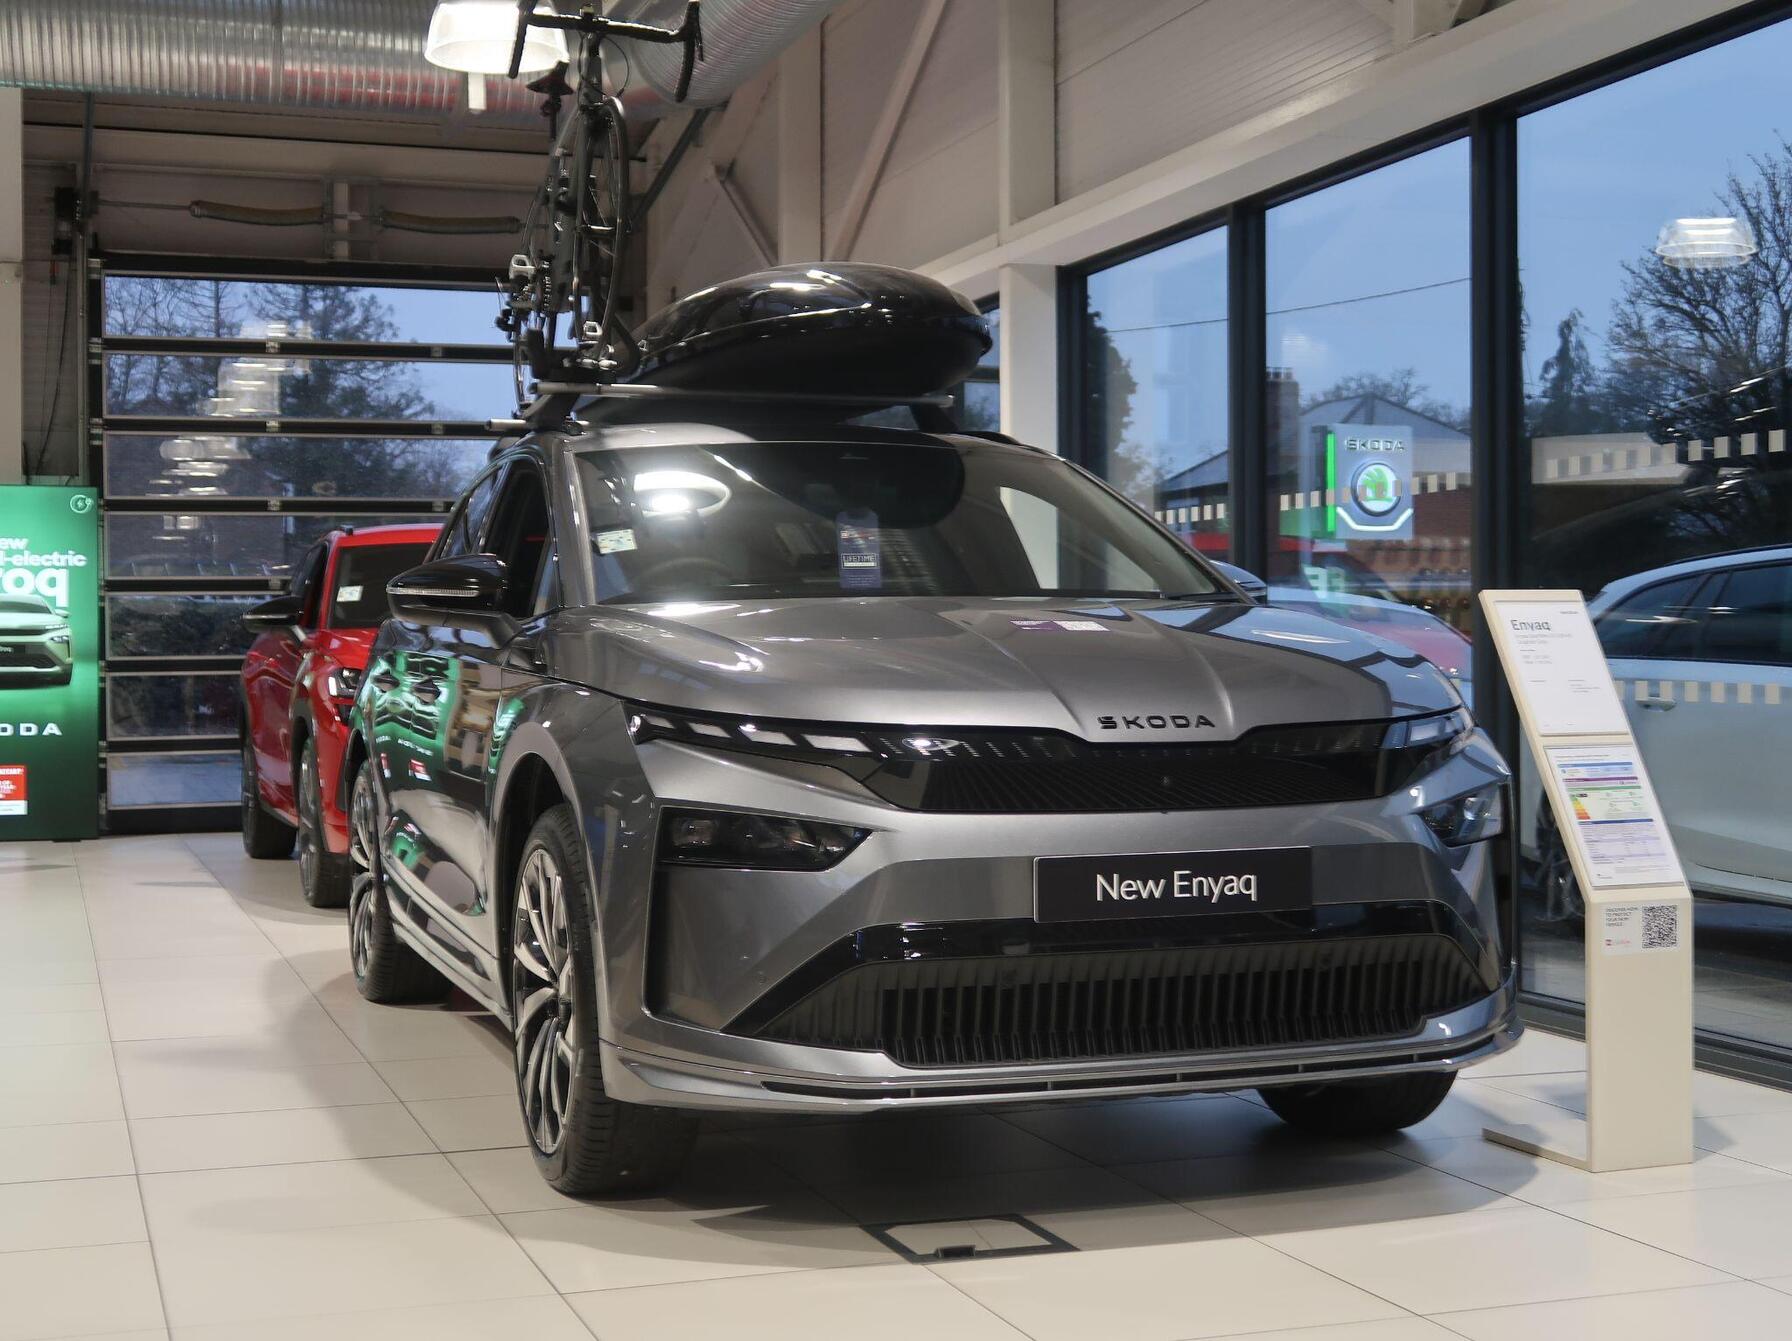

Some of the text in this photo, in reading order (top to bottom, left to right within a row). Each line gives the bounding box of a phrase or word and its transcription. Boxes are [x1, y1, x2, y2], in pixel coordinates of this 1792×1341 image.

[0, 567, 69, 607] oq
[1510, 619, 1551, 631] Enyaq
[1096, 870, 1258, 903] New Enyaq
